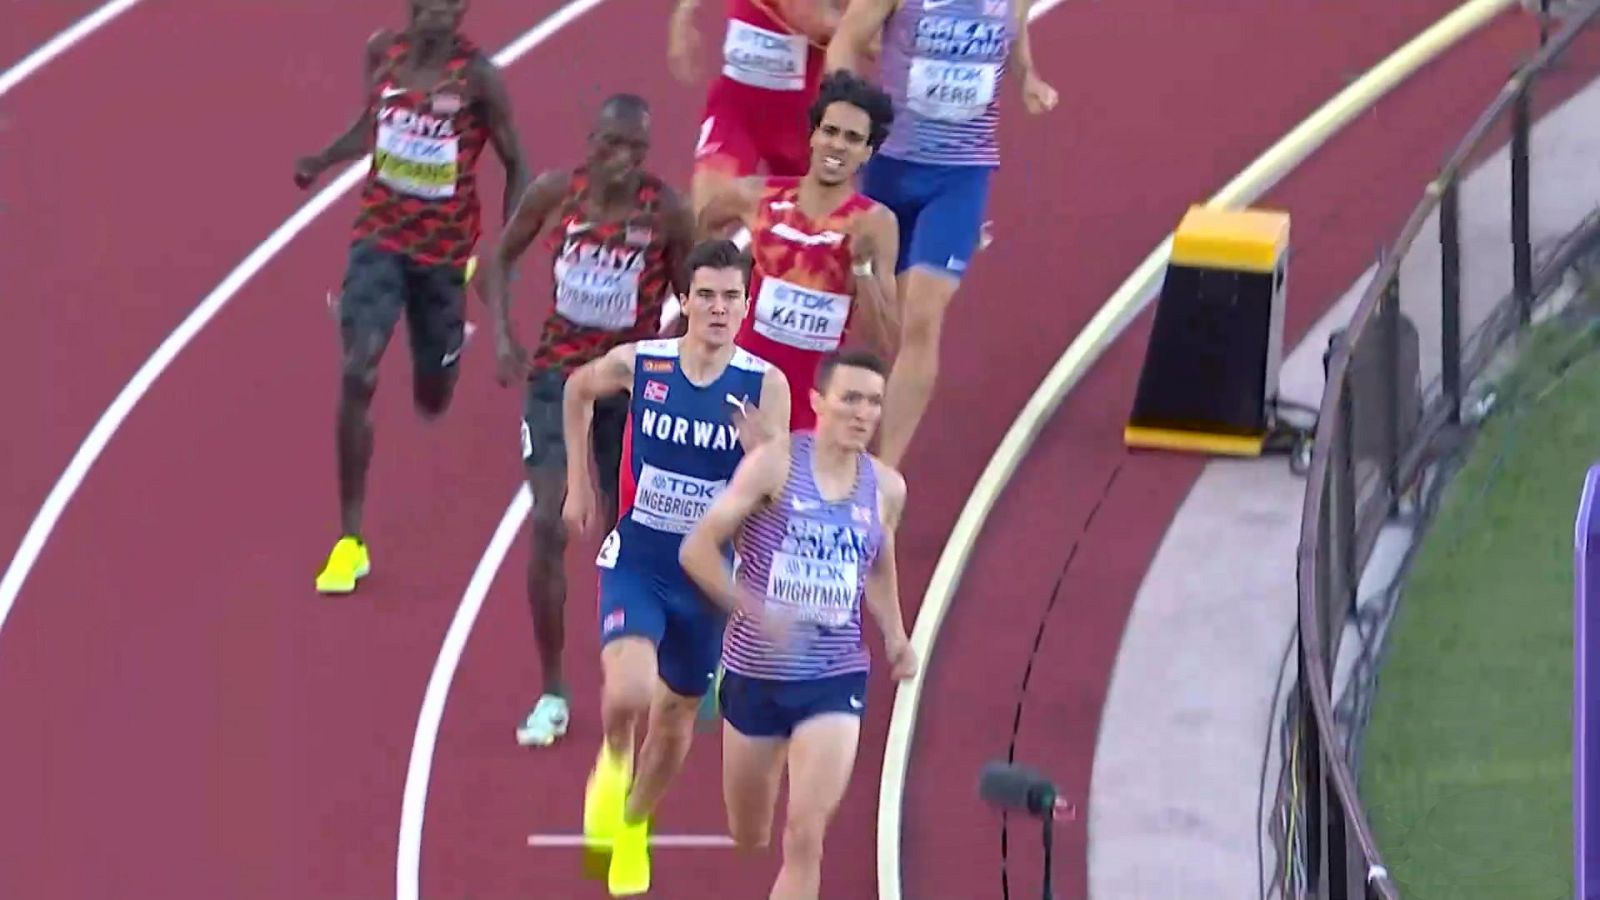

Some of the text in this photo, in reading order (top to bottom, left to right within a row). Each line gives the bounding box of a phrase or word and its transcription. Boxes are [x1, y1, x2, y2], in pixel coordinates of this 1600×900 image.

[942, 67, 983, 81] TDK
[926, 84, 979, 105] KERR
[563, 238, 646, 273] KENYA
[789, 288, 835, 313] TDK
[770, 305, 830, 334] KATIR
[641, 408, 740, 451] NORWAY
[668, 477, 716, 499] TDK
[639, 487, 709, 519] INGEBRIGTS
[600, 534, 615, 560] 2
[804, 562, 846, 582] TDK
[773, 575, 853, 609] WIGHTMAN
